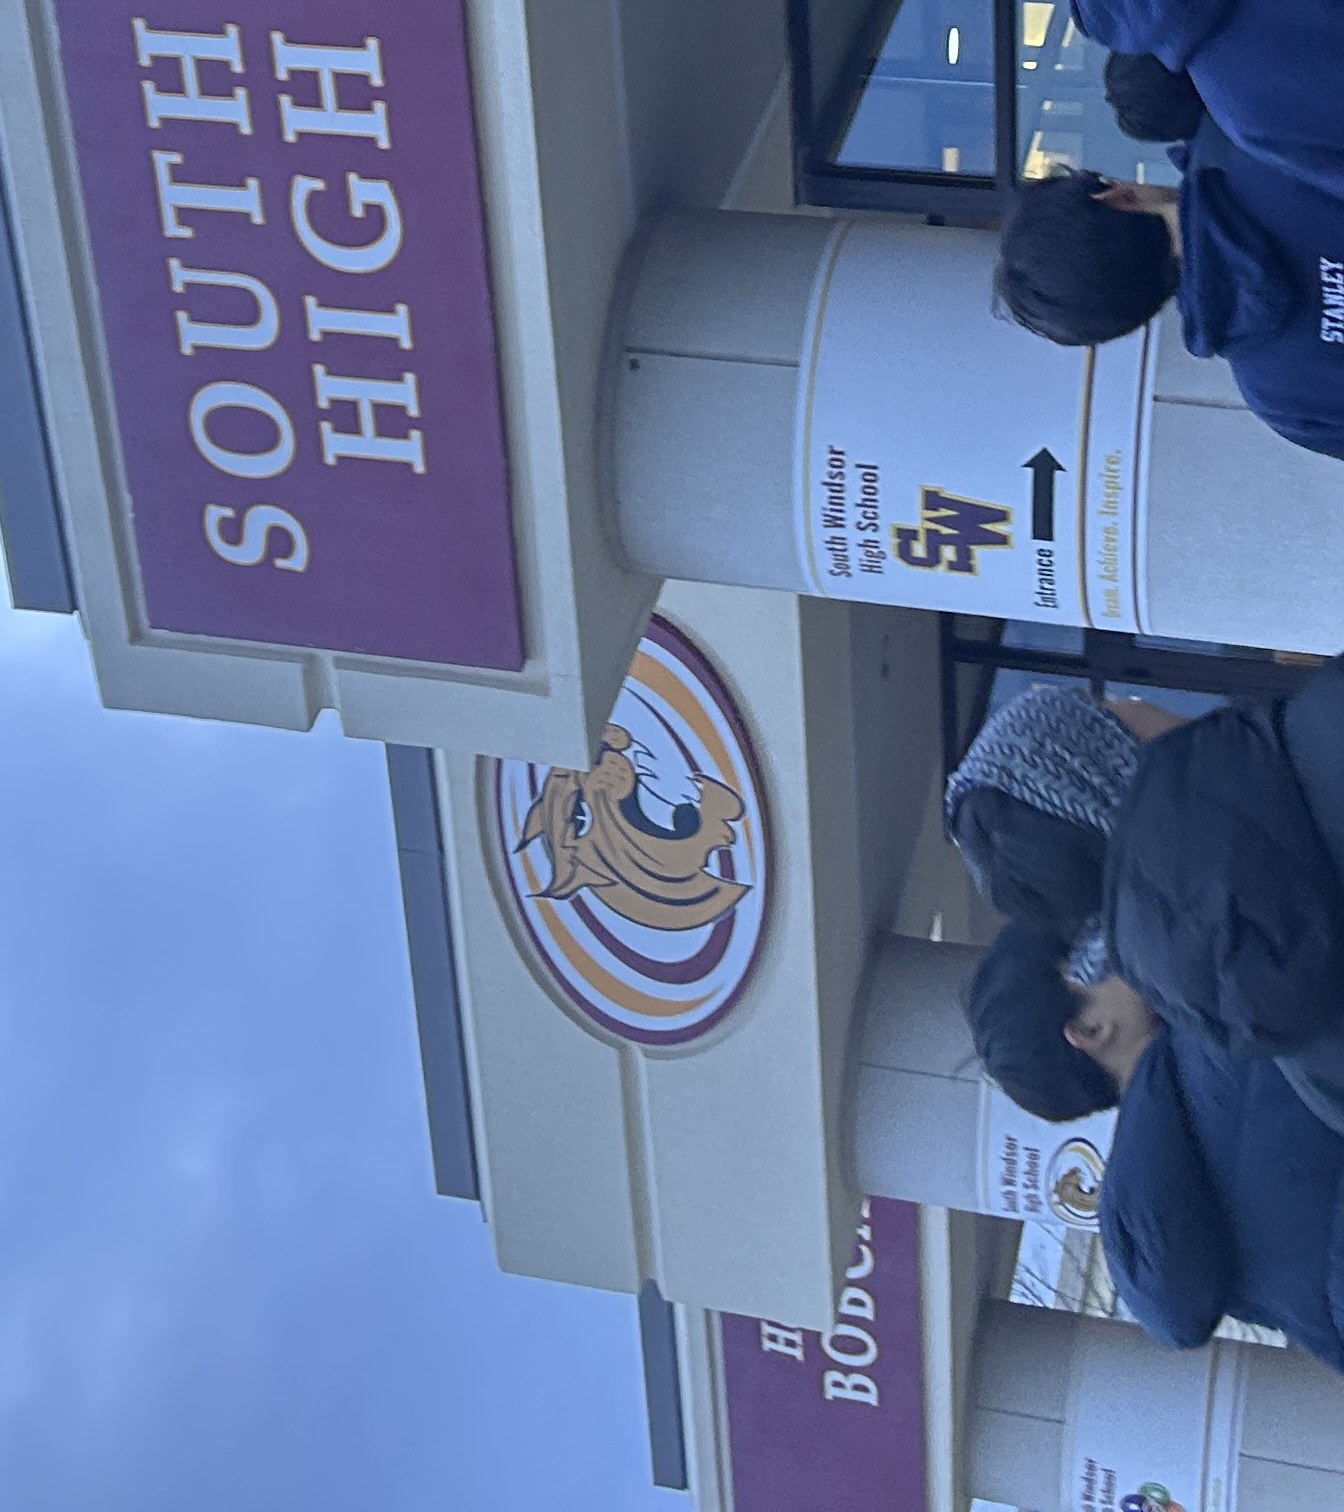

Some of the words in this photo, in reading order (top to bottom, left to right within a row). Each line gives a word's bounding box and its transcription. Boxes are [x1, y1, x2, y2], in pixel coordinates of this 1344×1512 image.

[269, 30, 426, 474] HIGH
[131, 17, 311, 572] SOUTH
[818, 444, 847, 529] Windsor
[853, 462, 880, 533] School
[822, 535, 853, 578] South
[855, 538, 888, 574] High
[888, 484, 1015, 577] SW
[1033, 547, 1060, 609] Entrance
[1021, 1146, 1041, 1191] School
